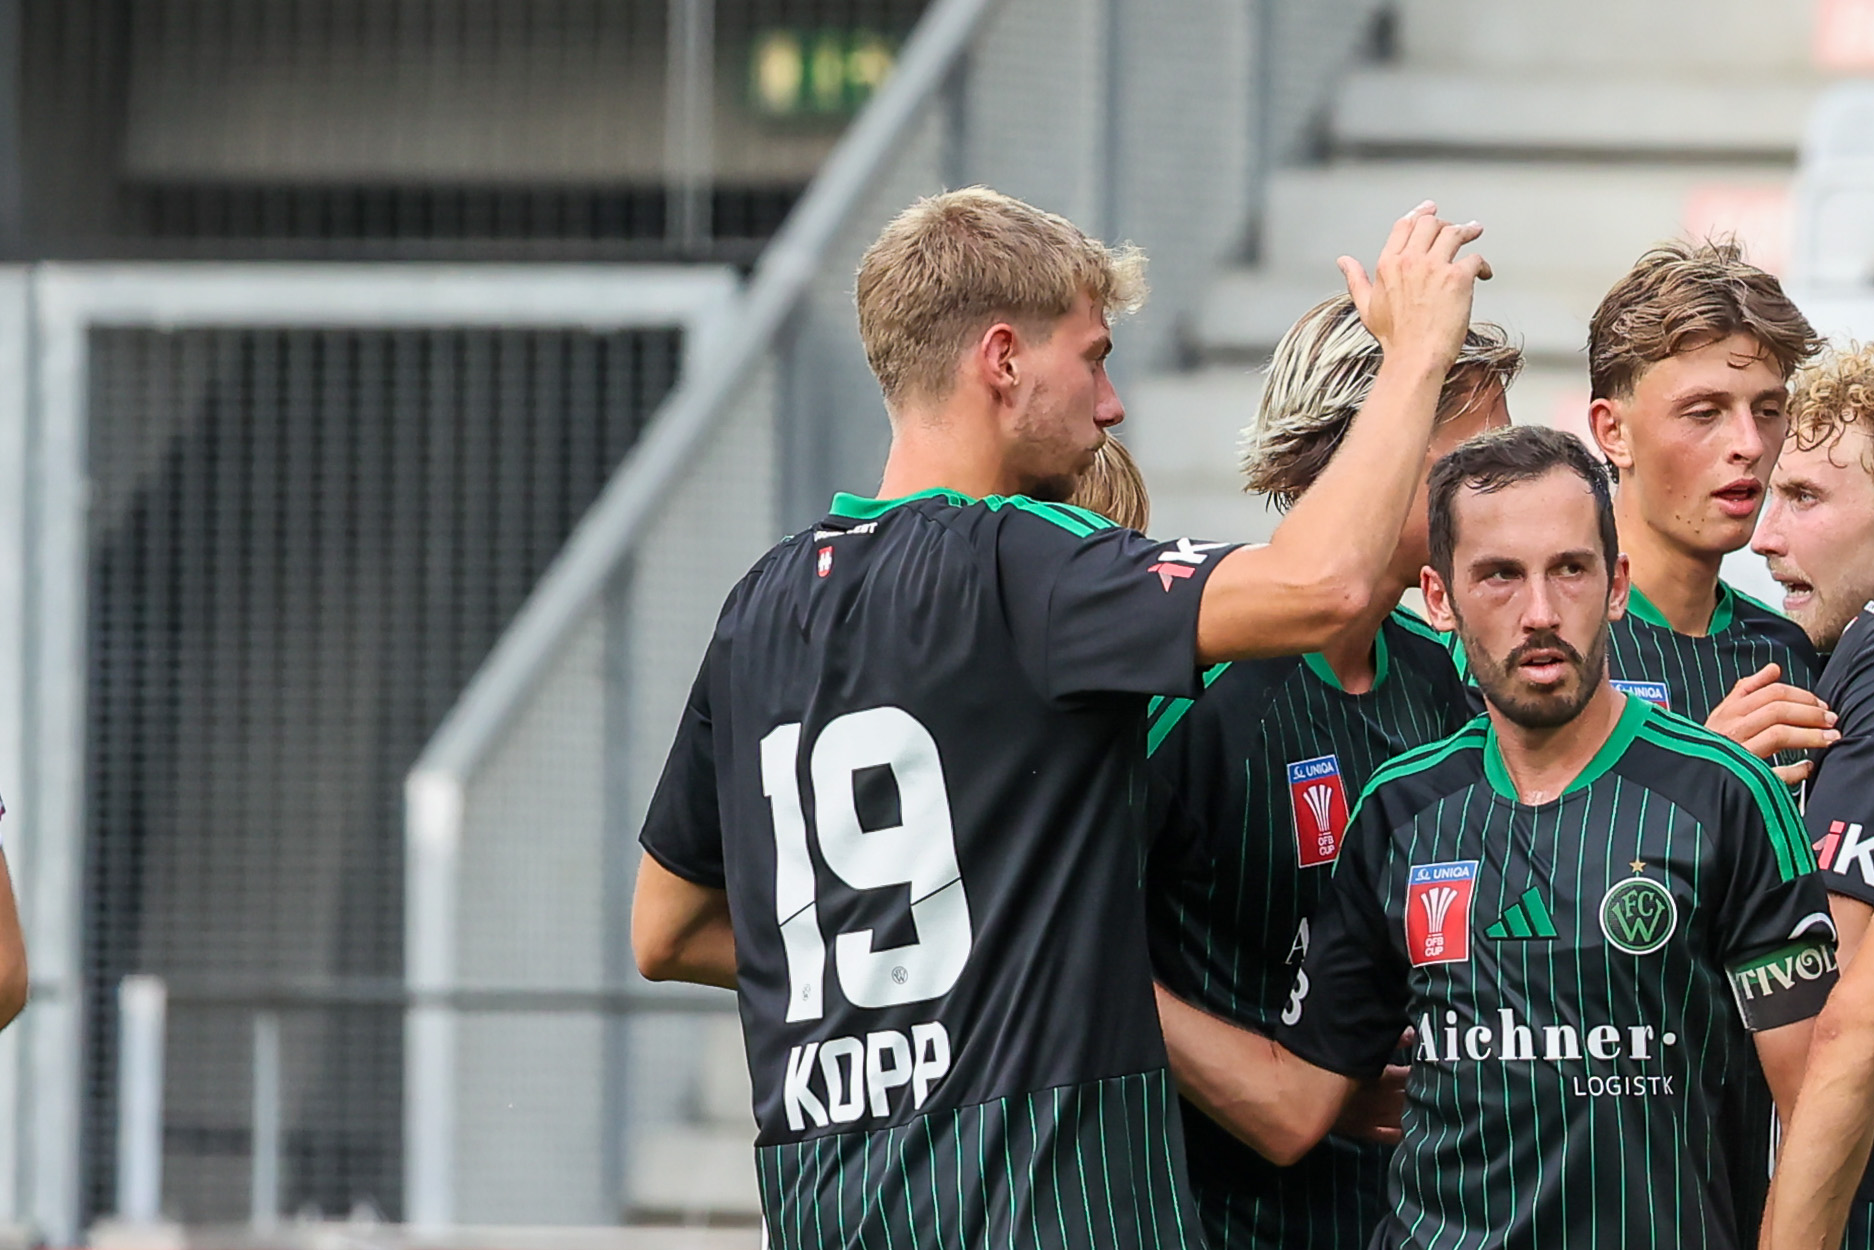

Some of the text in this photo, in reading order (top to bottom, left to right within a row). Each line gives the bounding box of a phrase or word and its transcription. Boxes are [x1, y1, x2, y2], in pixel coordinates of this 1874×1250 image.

[1305, 761, 1335, 777] UNIQA
[1319, 844, 1336, 856] CUP
[760, 706, 973, 1023] 19
[1433, 866, 1470, 879] UNIQA
[1425, 945, 1444, 957] CUP
[784, 1021, 951, 1132] KOPP
